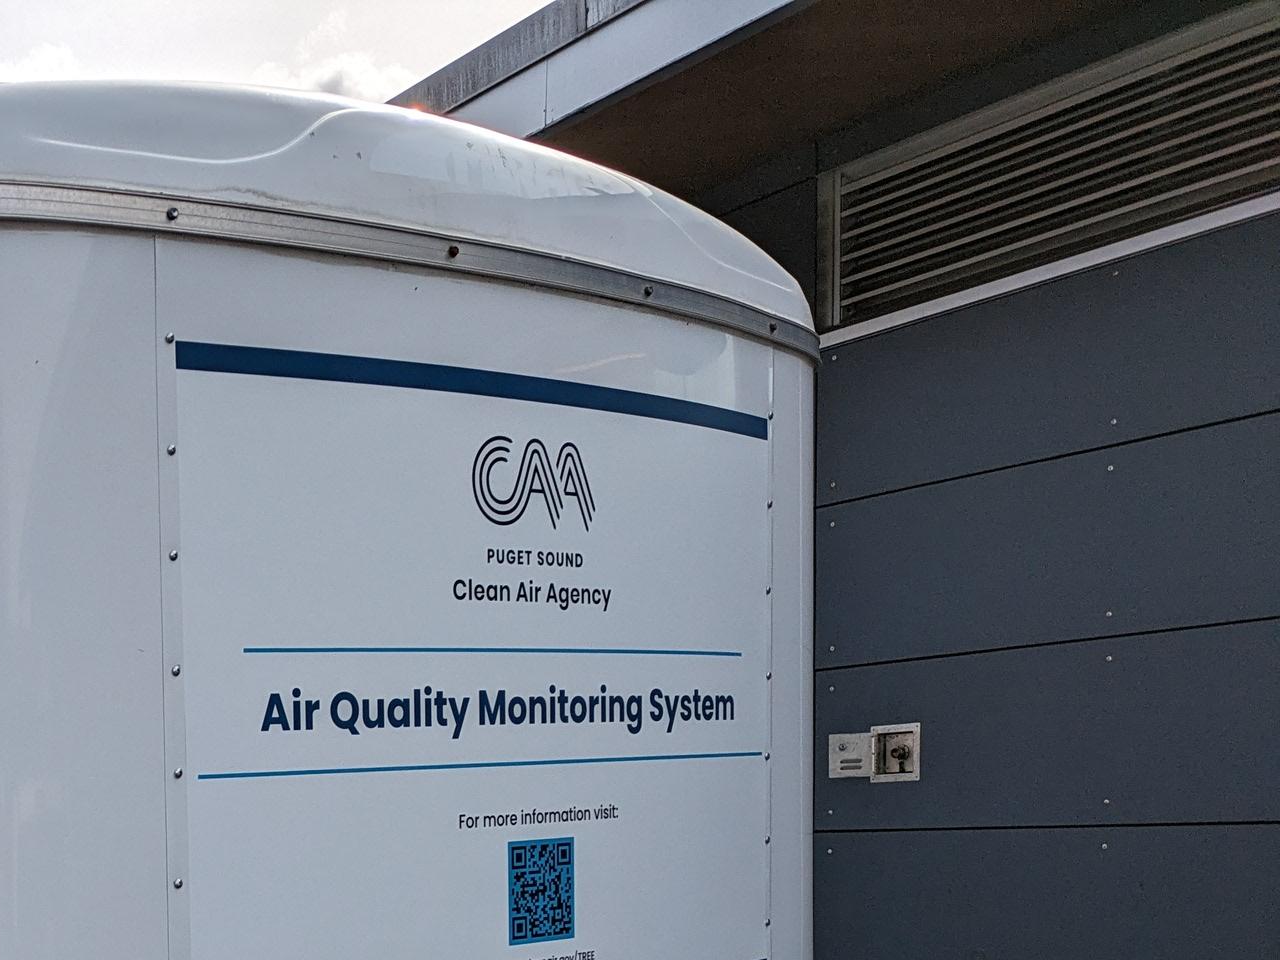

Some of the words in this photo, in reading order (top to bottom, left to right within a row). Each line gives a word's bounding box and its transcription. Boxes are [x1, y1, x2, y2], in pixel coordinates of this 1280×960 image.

[471, 434, 596, 532] CAA
[487, 548, 532, 566] PUGET
[537, 550, 584, 568] SOUND
[452, 578, 511, 602] Clean
[516, 579, 542, 603] Air
[546, 582, 612, 612] Agency
[260, 687, 320, 732] Air
[329, 685, 470, 740] Quality
[477, 684, 643, 735] Monitoring
[649, 687, 736, 733] System
[458, 813, 480, 830] For
[483, 813, 518, 828] more
[521, 805, 591, 826] information
[593, 803, 619, 821] visit:
